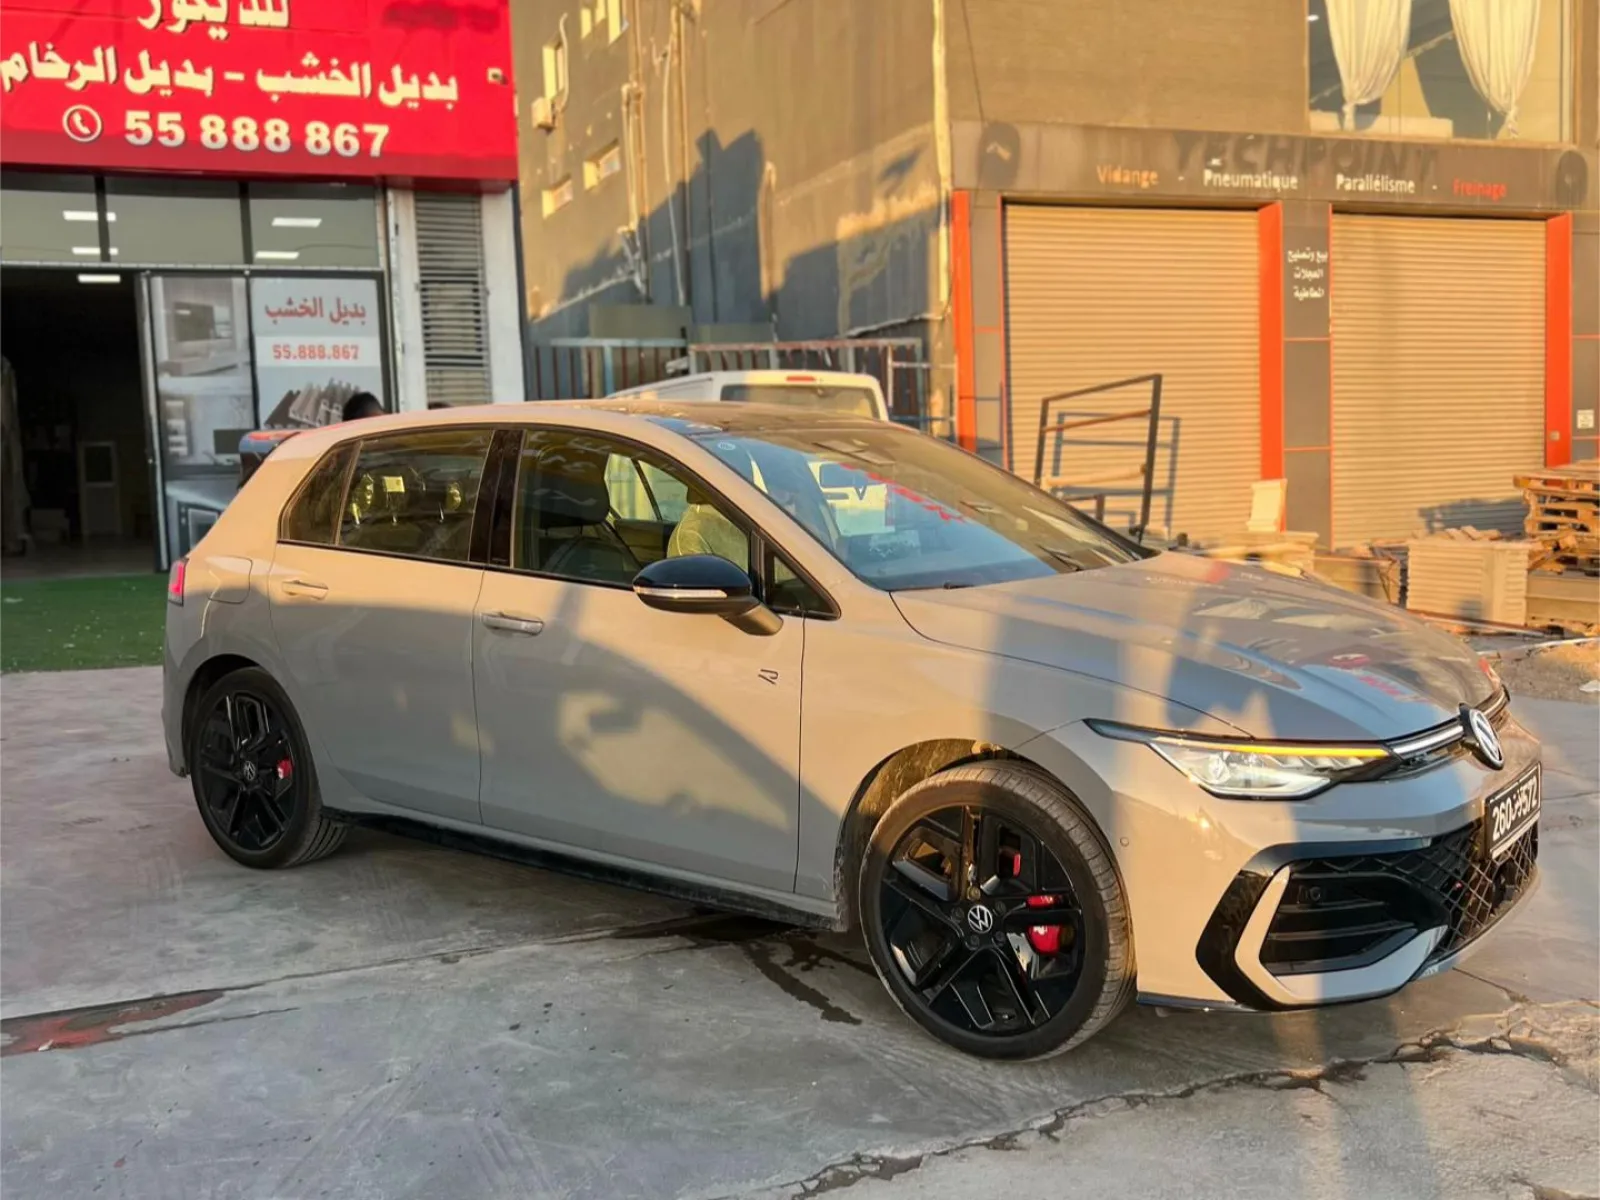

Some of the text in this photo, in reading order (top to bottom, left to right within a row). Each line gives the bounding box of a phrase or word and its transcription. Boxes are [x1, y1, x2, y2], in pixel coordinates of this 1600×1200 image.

[0, 41, 117, 93] الرخام
[124, 49, 213, 97] بديل
[256, 51, 371, 102] الخشب
[379, 64, 458, 110] بديل
[124, 110, 389, 158] 55 888 867
[1096, 164, 1507, 204] Vidange Pneumatique Parallélisme Freinage
[264, 296, 366, 326] بديل الخشب
[272, 344, 360, 360] 55.888.867
[1492, 804, 1512, 841] 260
